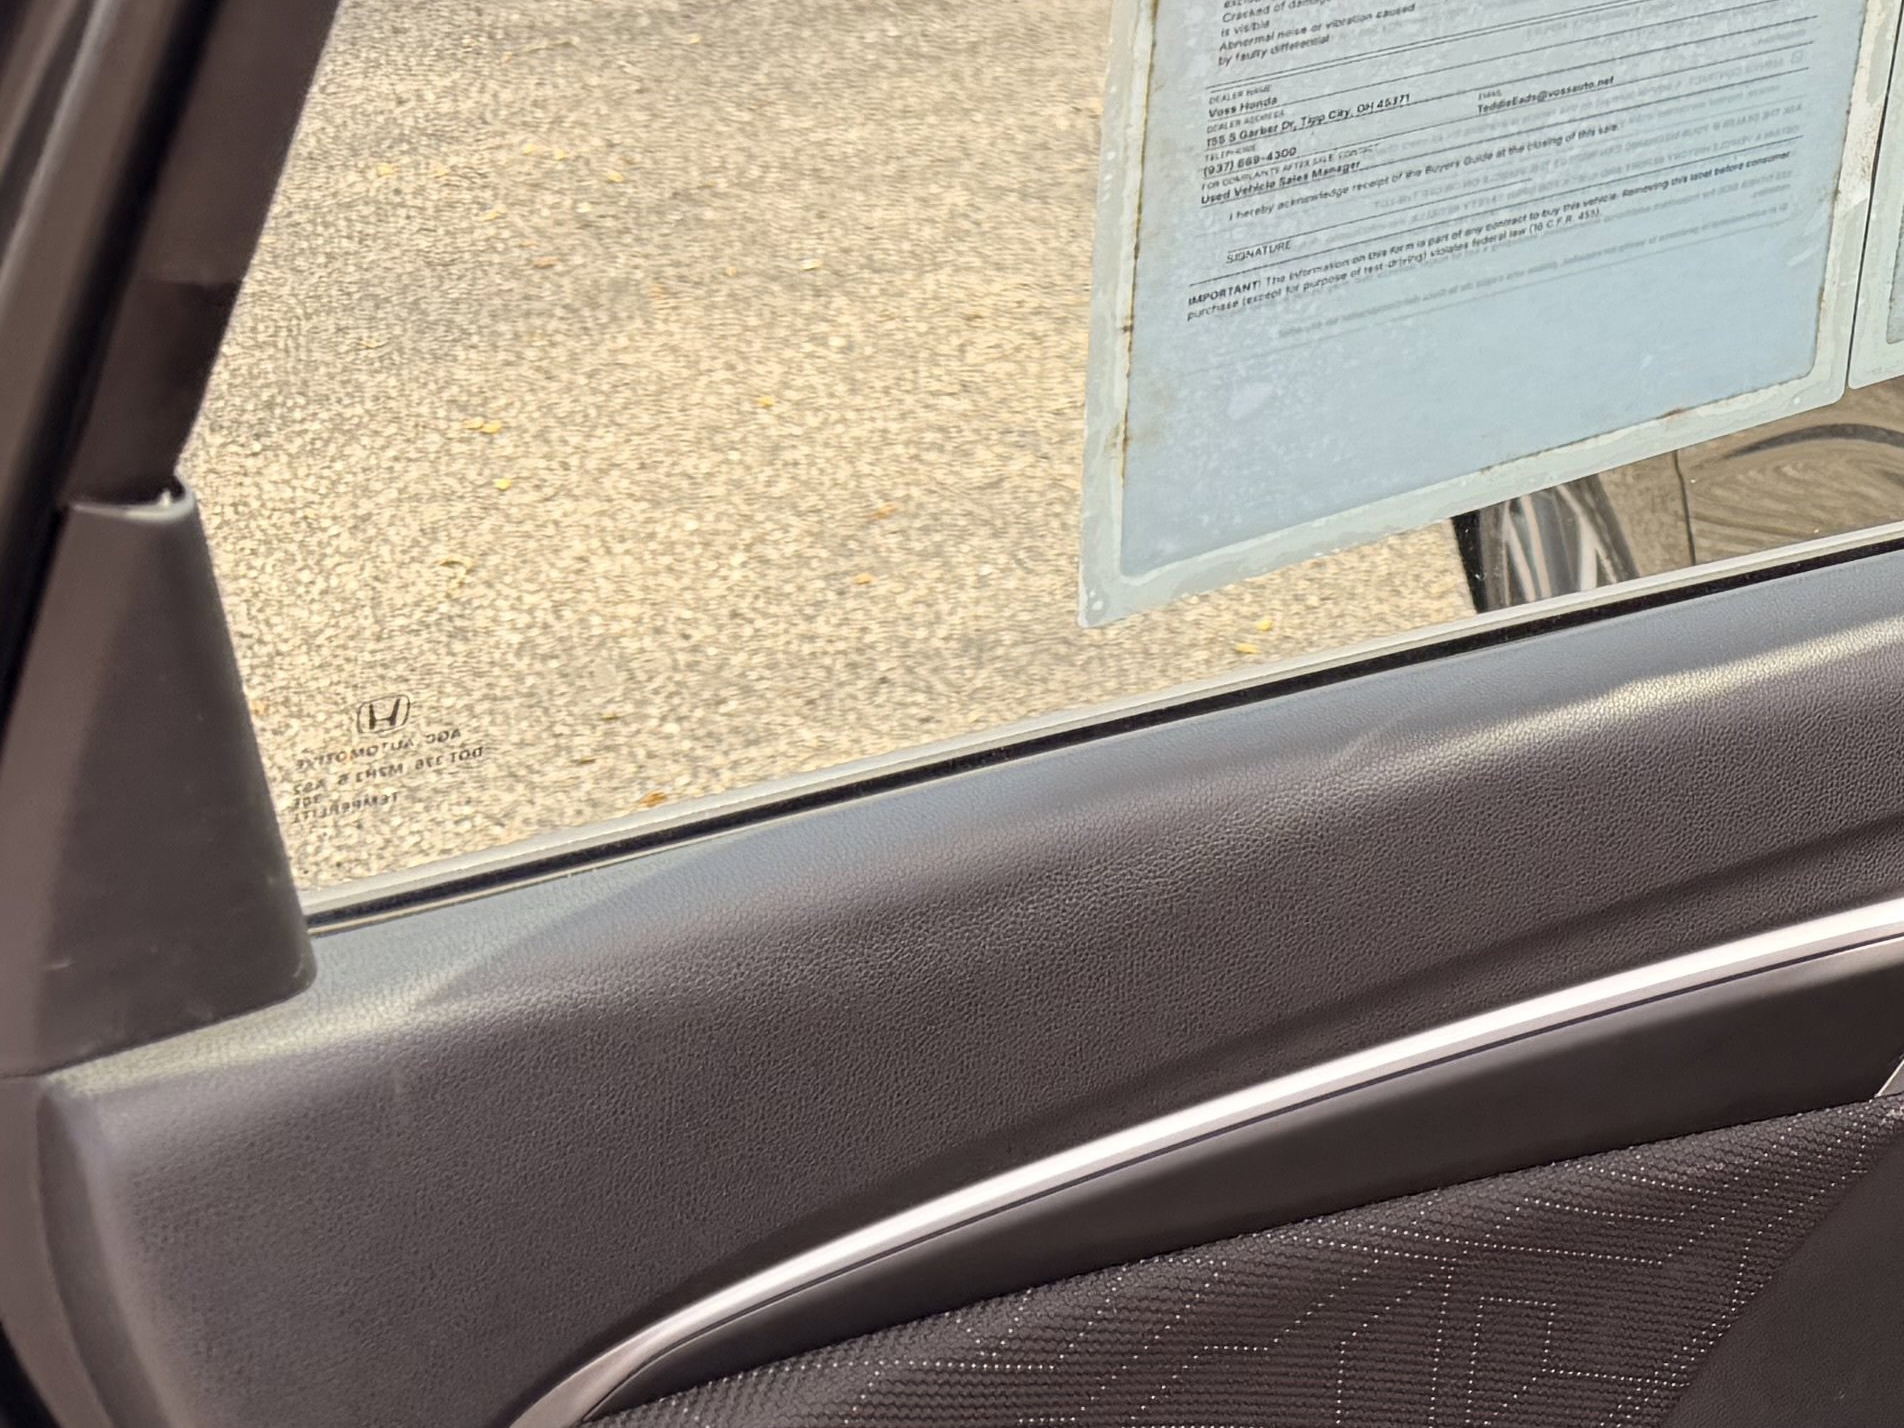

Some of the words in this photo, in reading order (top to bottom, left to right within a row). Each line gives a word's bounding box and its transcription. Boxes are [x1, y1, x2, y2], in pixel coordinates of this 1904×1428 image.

[1207, 102, 1237, 119] Voss
[1239, 94, 1278, 112] Honda
[1201, 190, 1231, 205] Used
[1233, 179, 1276, 198] Vehicle
[1279, 172, 1309, 188] Sales
[1311, 161, 1360, 182] Manager
[1226, 240, 1291, 264] SIGNATURE
